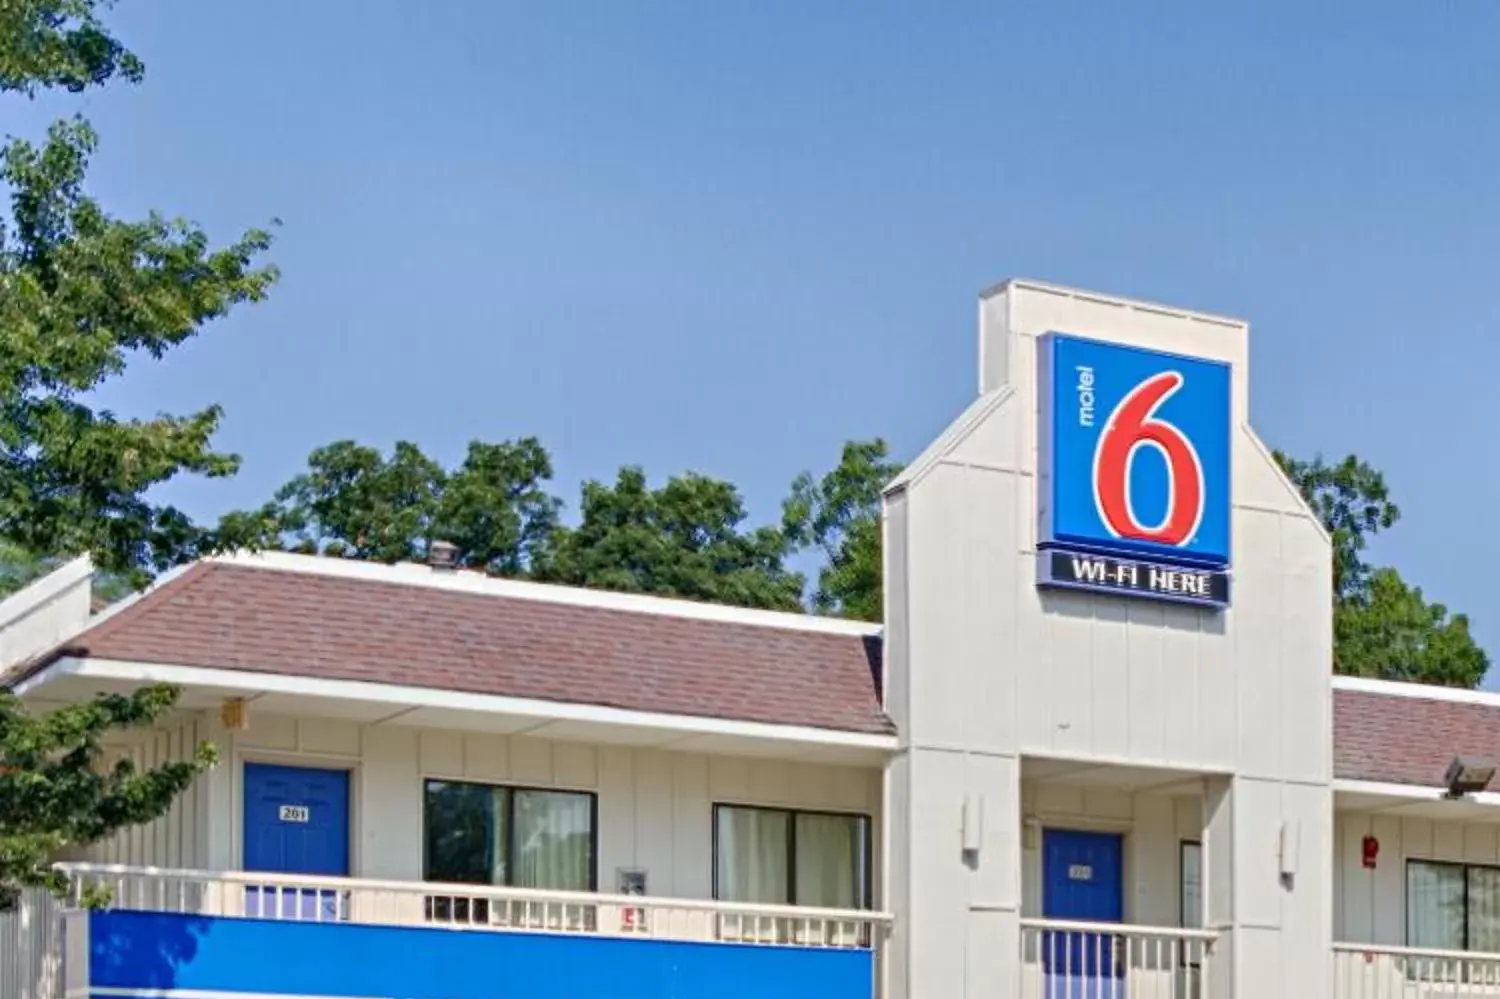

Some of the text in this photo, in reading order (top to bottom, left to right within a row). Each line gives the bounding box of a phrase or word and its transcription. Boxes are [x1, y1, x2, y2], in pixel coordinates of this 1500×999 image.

[1076, 366, 1096, 426] motel
[1092, 370, 1205, 548] 6
[1072, 558, 1212, 596] WI-FI HERE
[283, 807, 305, 820] 201
